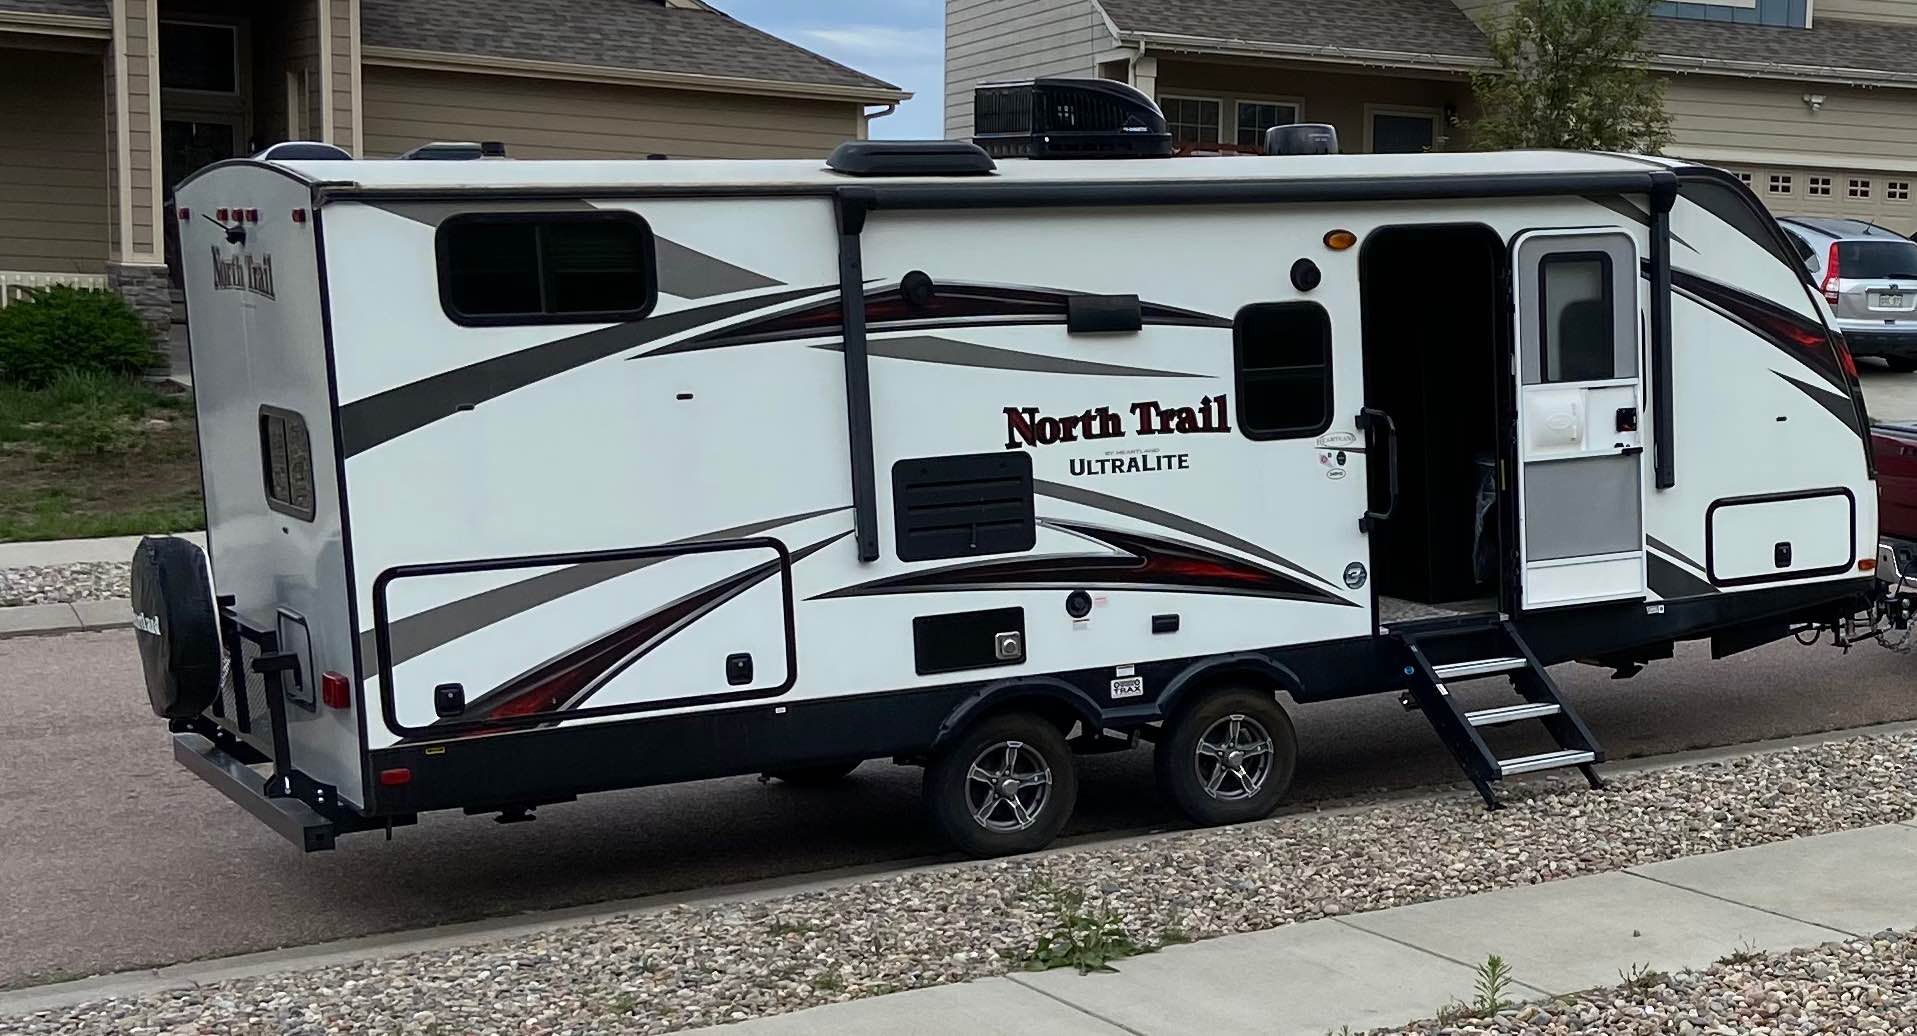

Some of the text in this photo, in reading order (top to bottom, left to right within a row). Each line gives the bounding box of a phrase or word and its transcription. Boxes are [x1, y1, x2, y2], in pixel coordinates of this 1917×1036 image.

[211, 245, 276, 301] North Trail
[1003, 393, 1232, 449] North Trail
